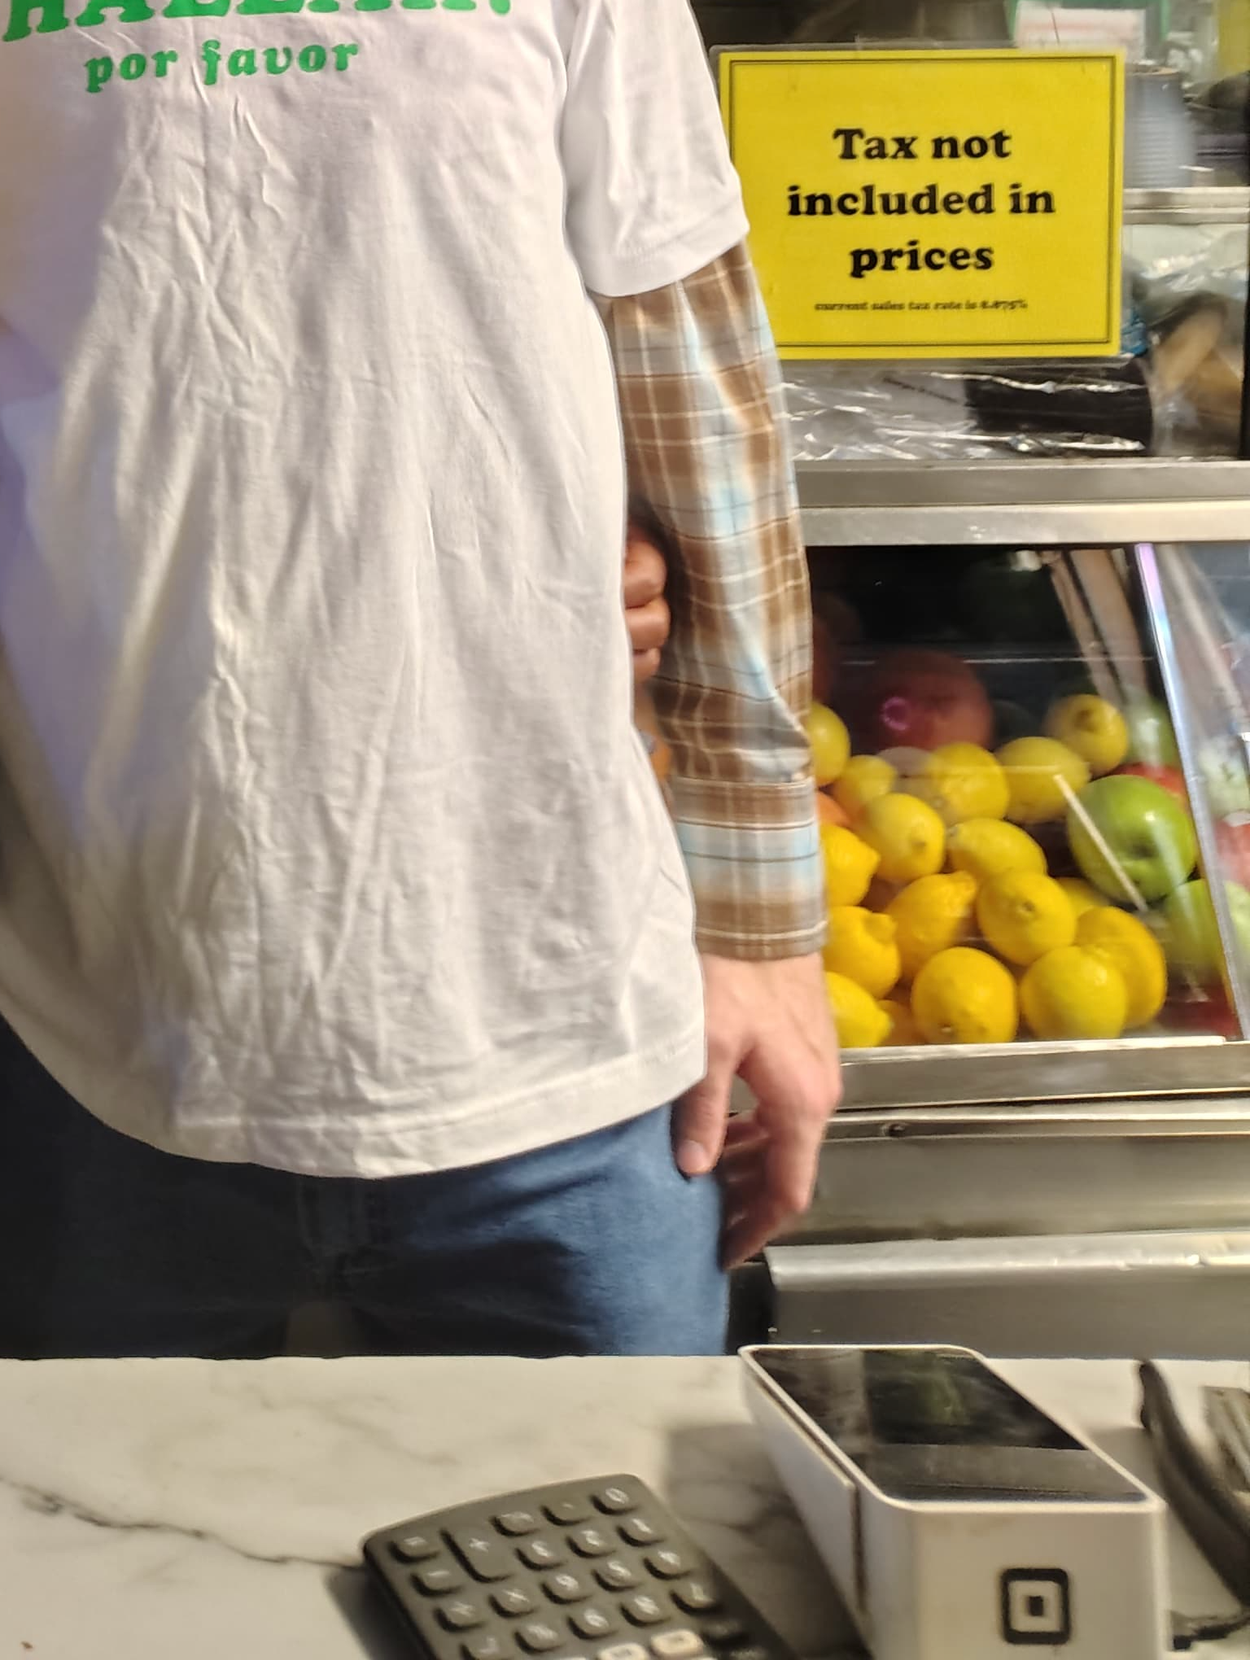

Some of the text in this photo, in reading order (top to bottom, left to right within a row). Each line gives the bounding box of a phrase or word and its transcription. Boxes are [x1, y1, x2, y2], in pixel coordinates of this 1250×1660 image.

[83, 39, 358, 93] por favor
[833, 128, 1011, 160] Tax not
[787, 183, 1055, 216] included in
[849, 239, 994, 279] prices
[815, 301, 868, 311] current
